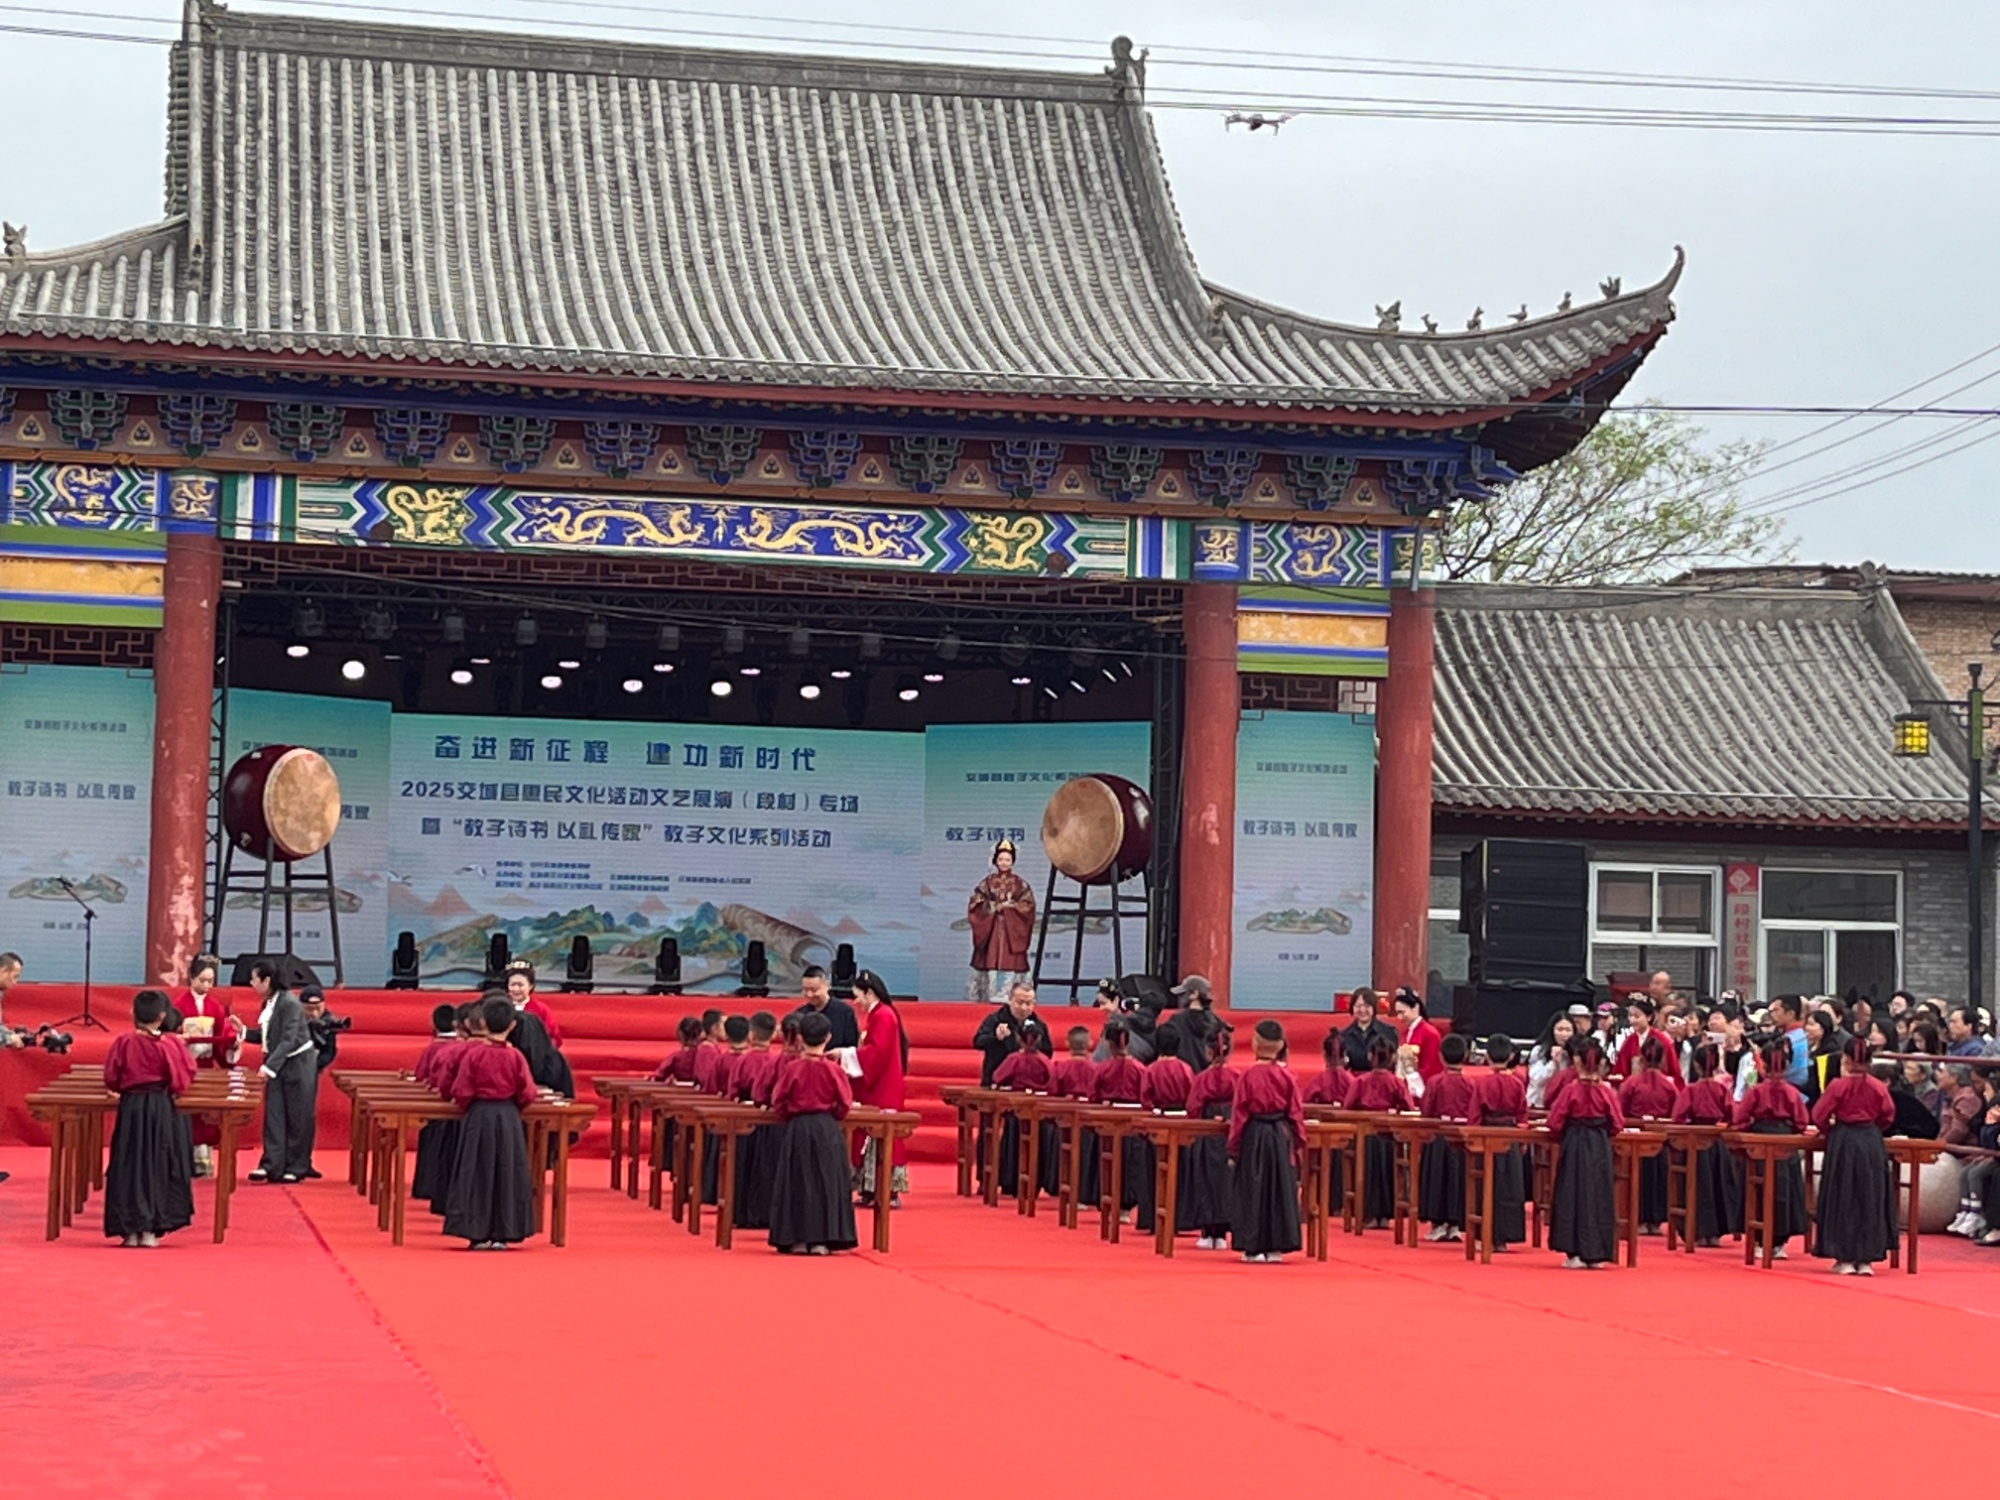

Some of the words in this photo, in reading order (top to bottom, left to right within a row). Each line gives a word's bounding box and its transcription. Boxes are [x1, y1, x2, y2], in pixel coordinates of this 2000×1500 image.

[434, 735, 609, 764] 奋进新征程
[646, 741, 816, 772] 建功新时代
